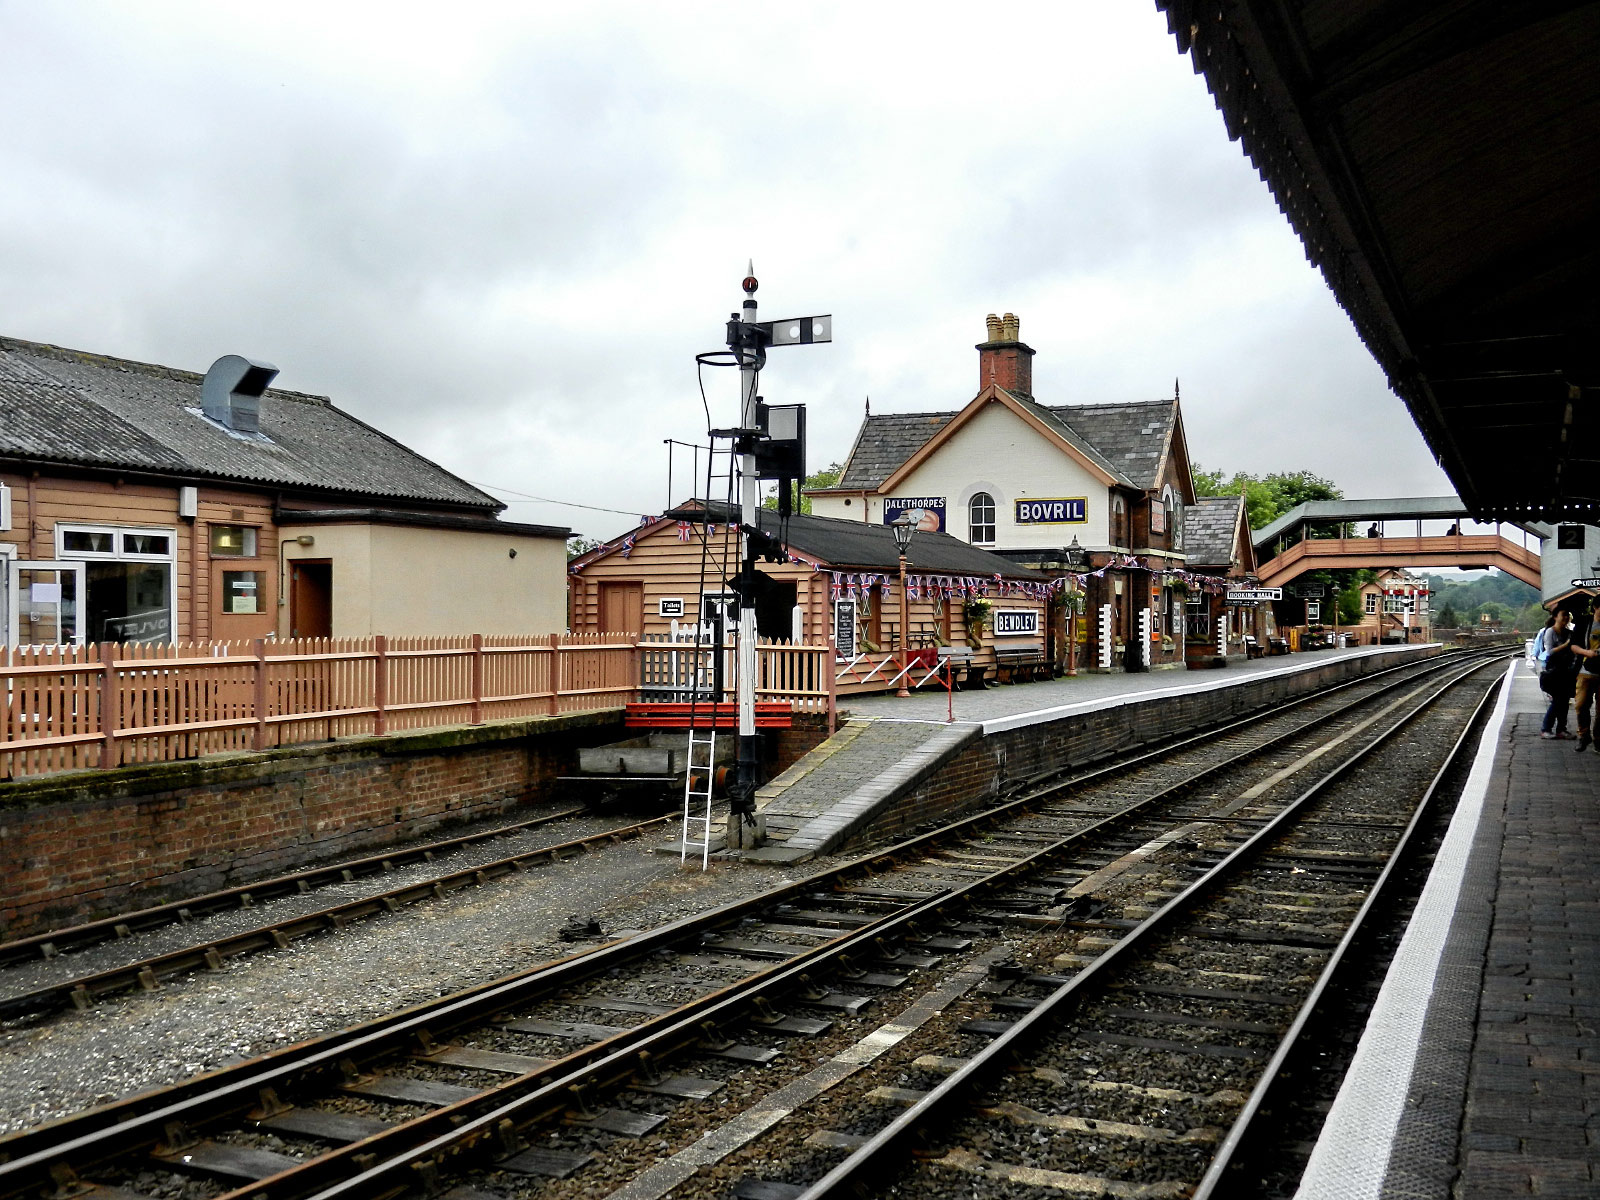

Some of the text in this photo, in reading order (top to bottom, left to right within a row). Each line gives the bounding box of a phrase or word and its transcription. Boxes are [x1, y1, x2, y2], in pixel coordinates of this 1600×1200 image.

[1020, 502, 1083, 520] BOVRIL
[1565, 530, 1578, 545] 2
[998, 615, 1035, 631] BEWDLEY
